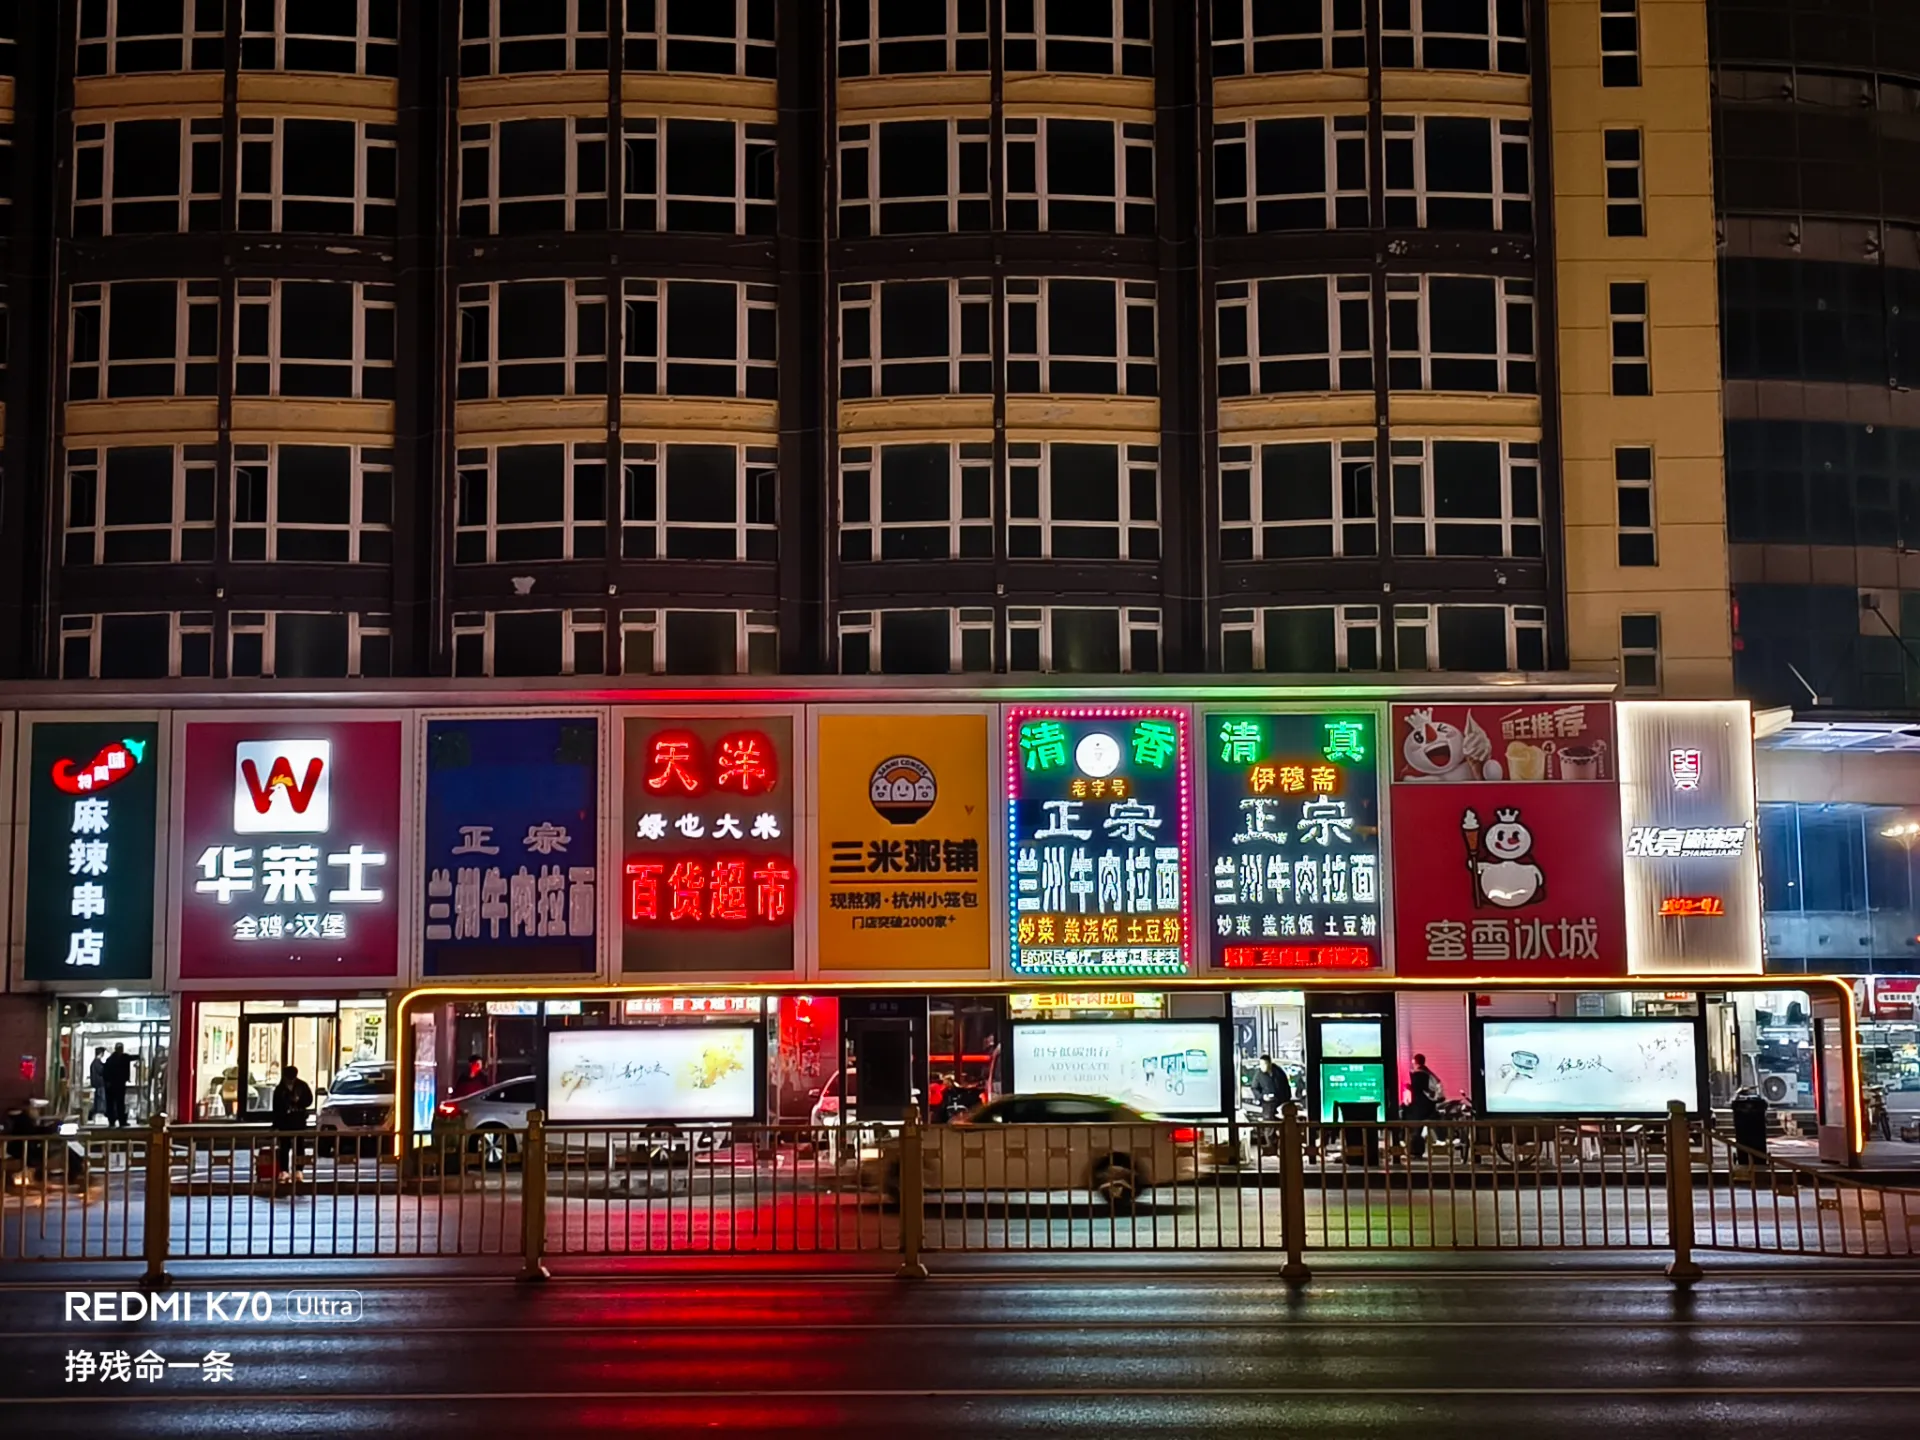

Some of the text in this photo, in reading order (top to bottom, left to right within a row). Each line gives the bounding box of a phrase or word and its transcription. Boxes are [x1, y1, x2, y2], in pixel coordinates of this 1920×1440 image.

[1219, 721, 1365, 762] 清真
[648, 740, 767, 791] 天洋
[1250, 766, 1337, 793] 伊穆斋
[1072, 779, 1125, 797] 老字号
[452, 822, 571, 854] 正宗
[1034, 798, 1162, 840] 正宗
[1232, 795, 1354, 847] 正宗
[829, 839, 979, 873] 三米粥铺
[1627, 827, 1746, 857] 张亮麻辣烫
[65, 797, 109, 966] 麻辣串店
[195, 845, 387, 904] 华莱士
[626, 862, 790, 920] 百货超市
[1017, 846, 1179, 913] 兰州牛肉拉面
[1214, 854, 1376, 905] 兰州牛肉拉面
[426, 865, 595, 939] 兰州牛肉拉面
[829, 892, 978, 909] 现熬粥·杭州小笼包
[233, 914, 347, 941] 全鸡·汉堡
[1018, 917, 1055, 944] 炒菜
[1127, 917, 1180, 944] 土豆粉
[1217, 914, 1376, 937] 炒菜 盖浇饭 土豆粉
[1425, 917, 1600, 961] 蜜雪冰城
[1049, 1062, 1109, 1070] ADVOCATE
